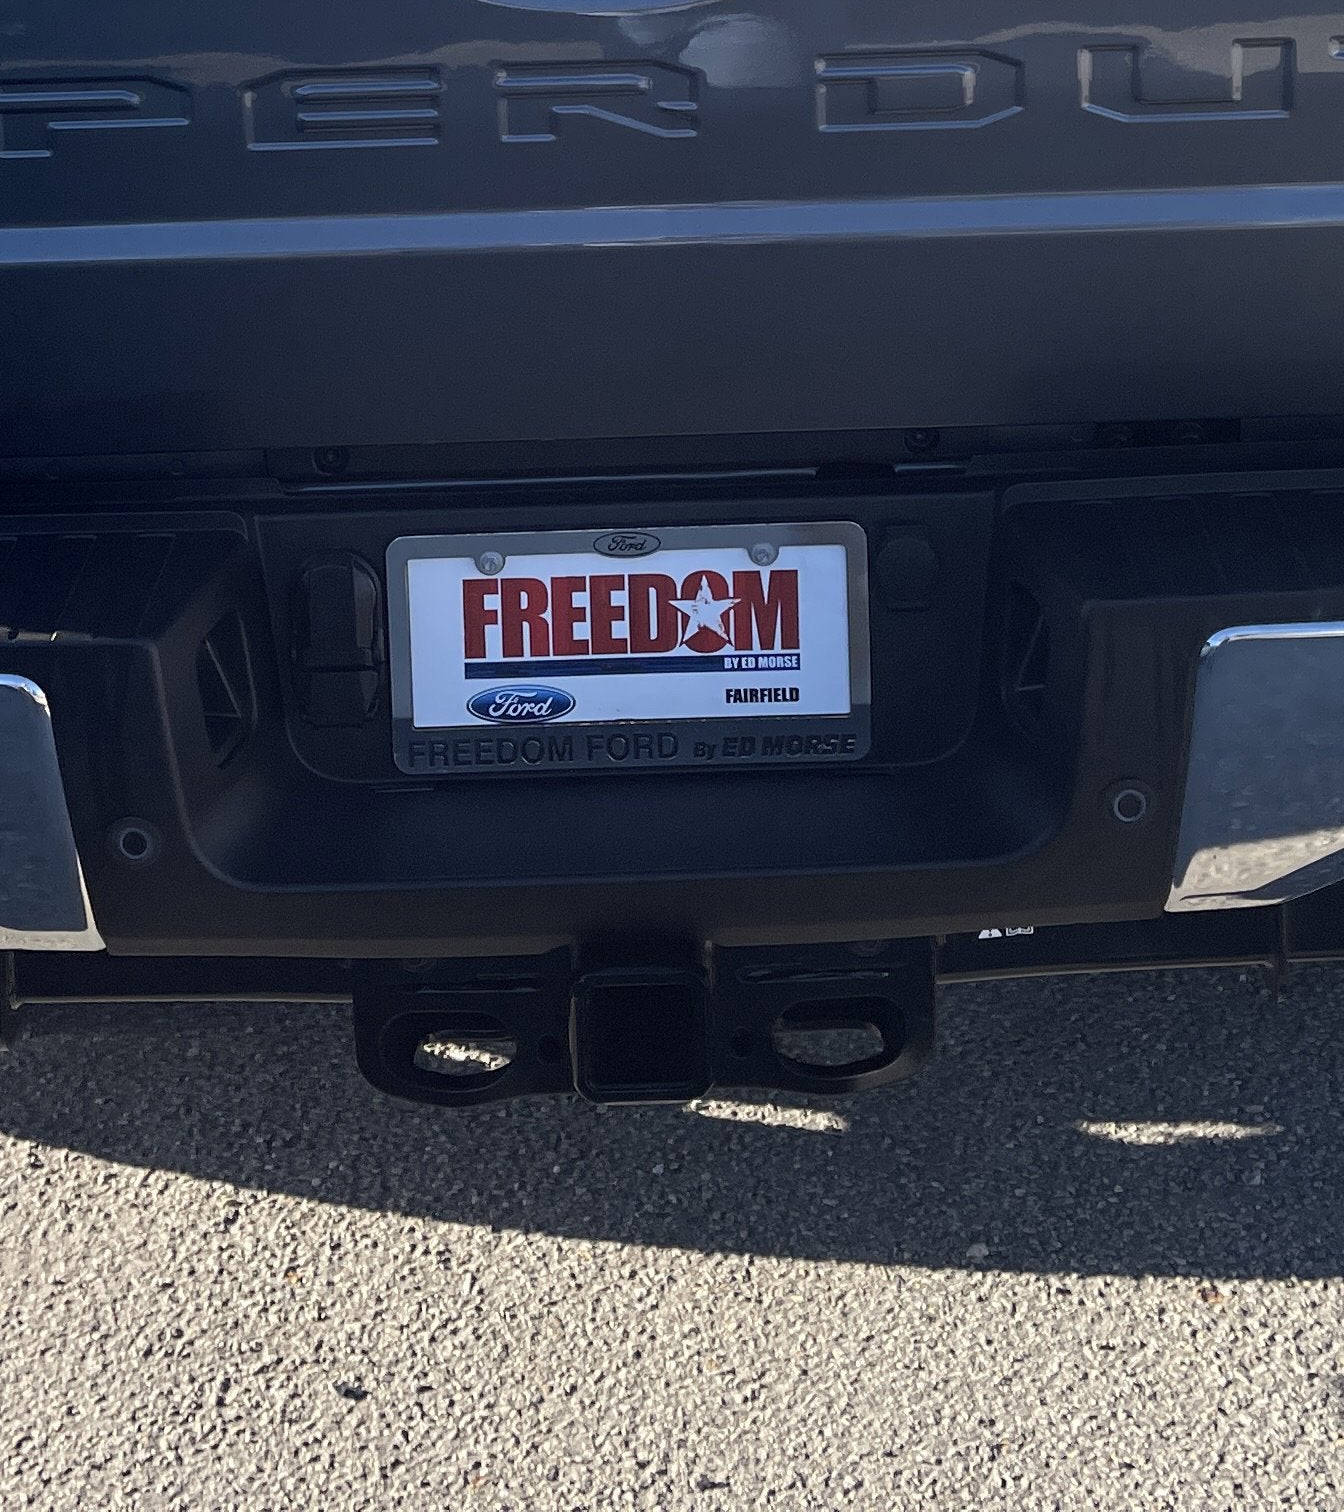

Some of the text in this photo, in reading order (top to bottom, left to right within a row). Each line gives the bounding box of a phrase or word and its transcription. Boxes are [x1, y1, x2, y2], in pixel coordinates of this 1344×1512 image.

[607, 535, 647, 552] Ford
[462, 569, 800, 660] FREEDOM
[724, 655, 799, 670] BY ED MORSE
[488, 691, 554, 718] Ford
[725, 687, 800, 704] FAIRFIELD
[407, 732, 857, 768] FREEDOM FORD By ED MORSE
